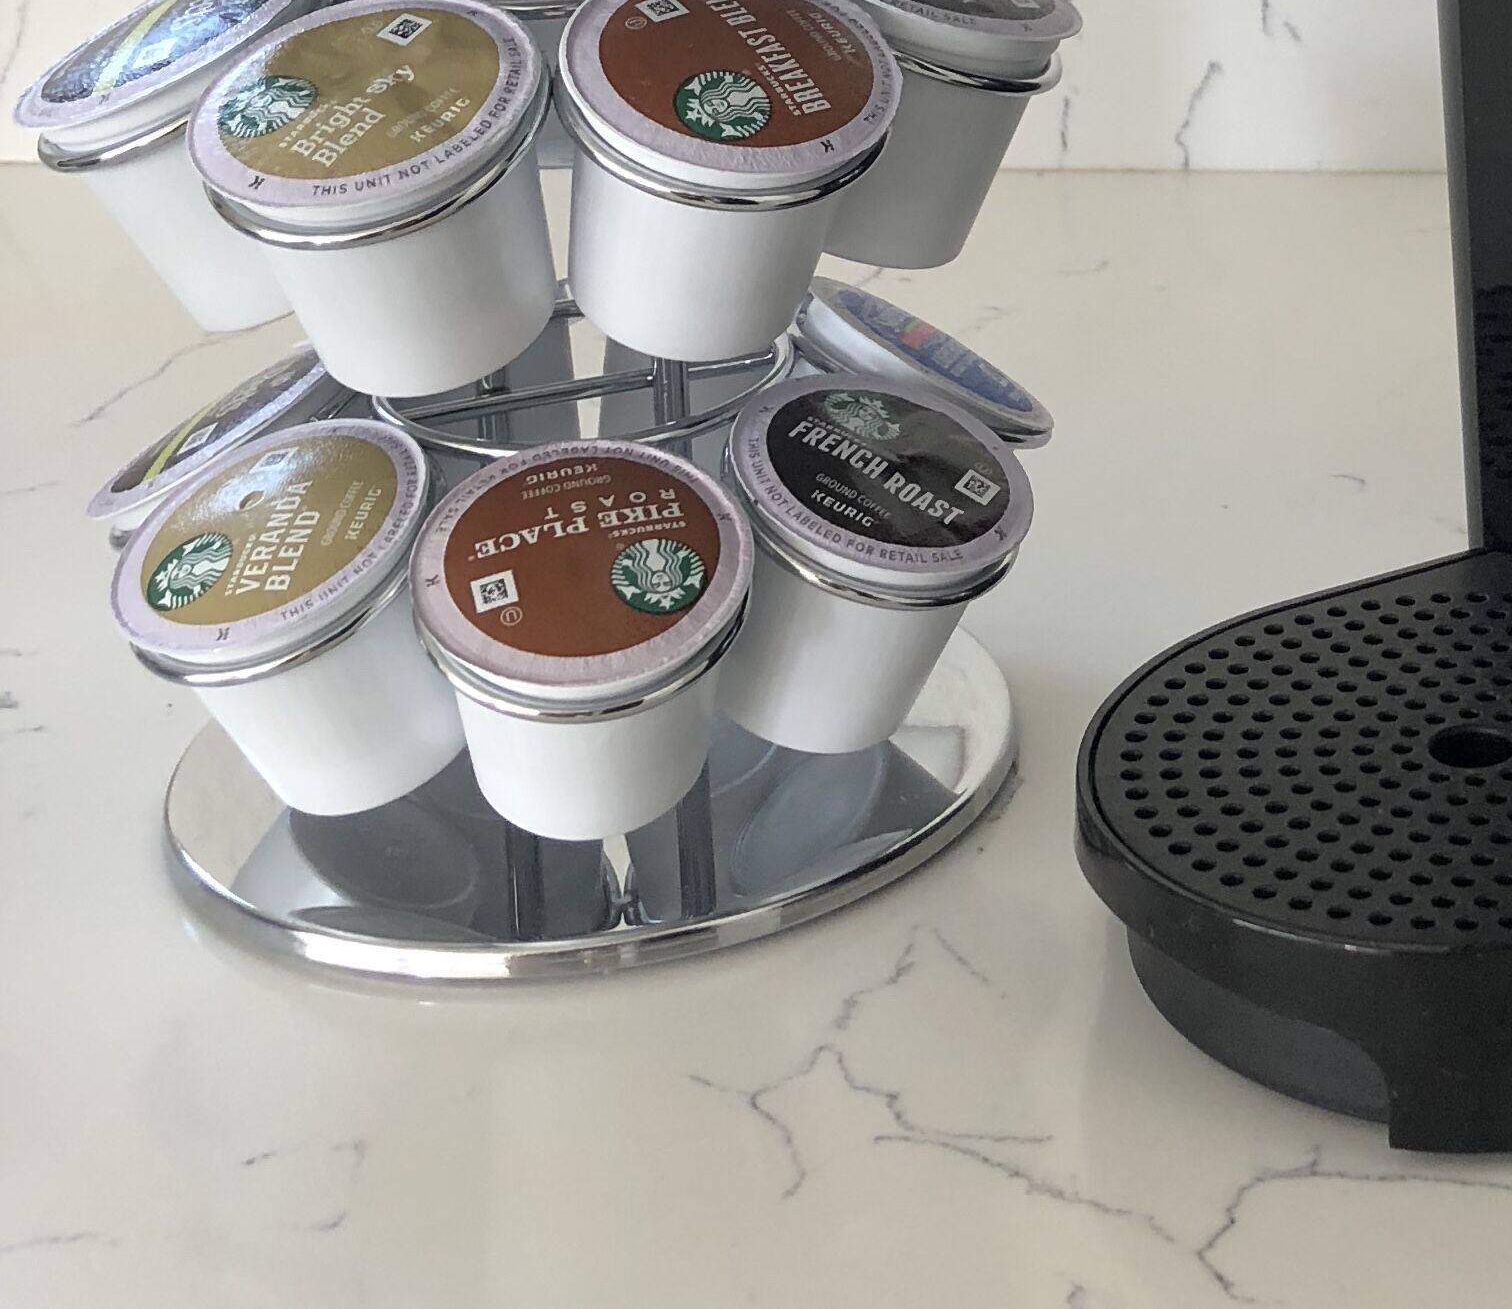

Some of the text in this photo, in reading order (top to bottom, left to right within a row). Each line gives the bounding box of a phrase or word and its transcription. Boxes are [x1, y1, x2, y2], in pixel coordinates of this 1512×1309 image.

[809, 12, 856, 56] KEURIG
[738, 27, 832, 115] BREAKFAST
[757, 64, 802, 117] STARBUCKS
[289, 96, 372, 157] Bright
[312, 184, 348, 197] THIS
[354, 173, 392, 192] UNIT
[398, 160, 431, 180] NOT
[435, 119, 493, 165] LABELED
[489, 96, 511, 119] FOR
[503, 59, 522, 96] RETAIL
[312, 107, 387, 168] Blend
[409, 96, 471, 144] KEURIG
[526, 463, 599, 485] KEURIG
[604, 445, 634, 457] NOT
[639, 451, 671, 466] UNIT
[672, 466, 700, 484] THIS
[788, 420, 965, 525] FRENCH ROAST
[344, 485, 383, 540] KEURIG
[520, 474, 612, 501] GROUND COFFEE
[544, 488, 677, 520] ROAST
[748, 437, 964, 564] THIS UNIT NOT LABELED FOR RETAIL SALE
[811, 489, 875, 528] KEURIG
[815, 473, 858, 499] GROUND
[236, 480, 313, 595] VERANDA
[264, 509, 321, 591] BLEND
[474, 501, 685, 559] PIKE PLACE
[612, 520, 687, 539] STARBUCKS
[280, 598, 315, 621] THIS
[319, 576, 350, 601] UNIT
[353, 552, 378, 576] NOT
